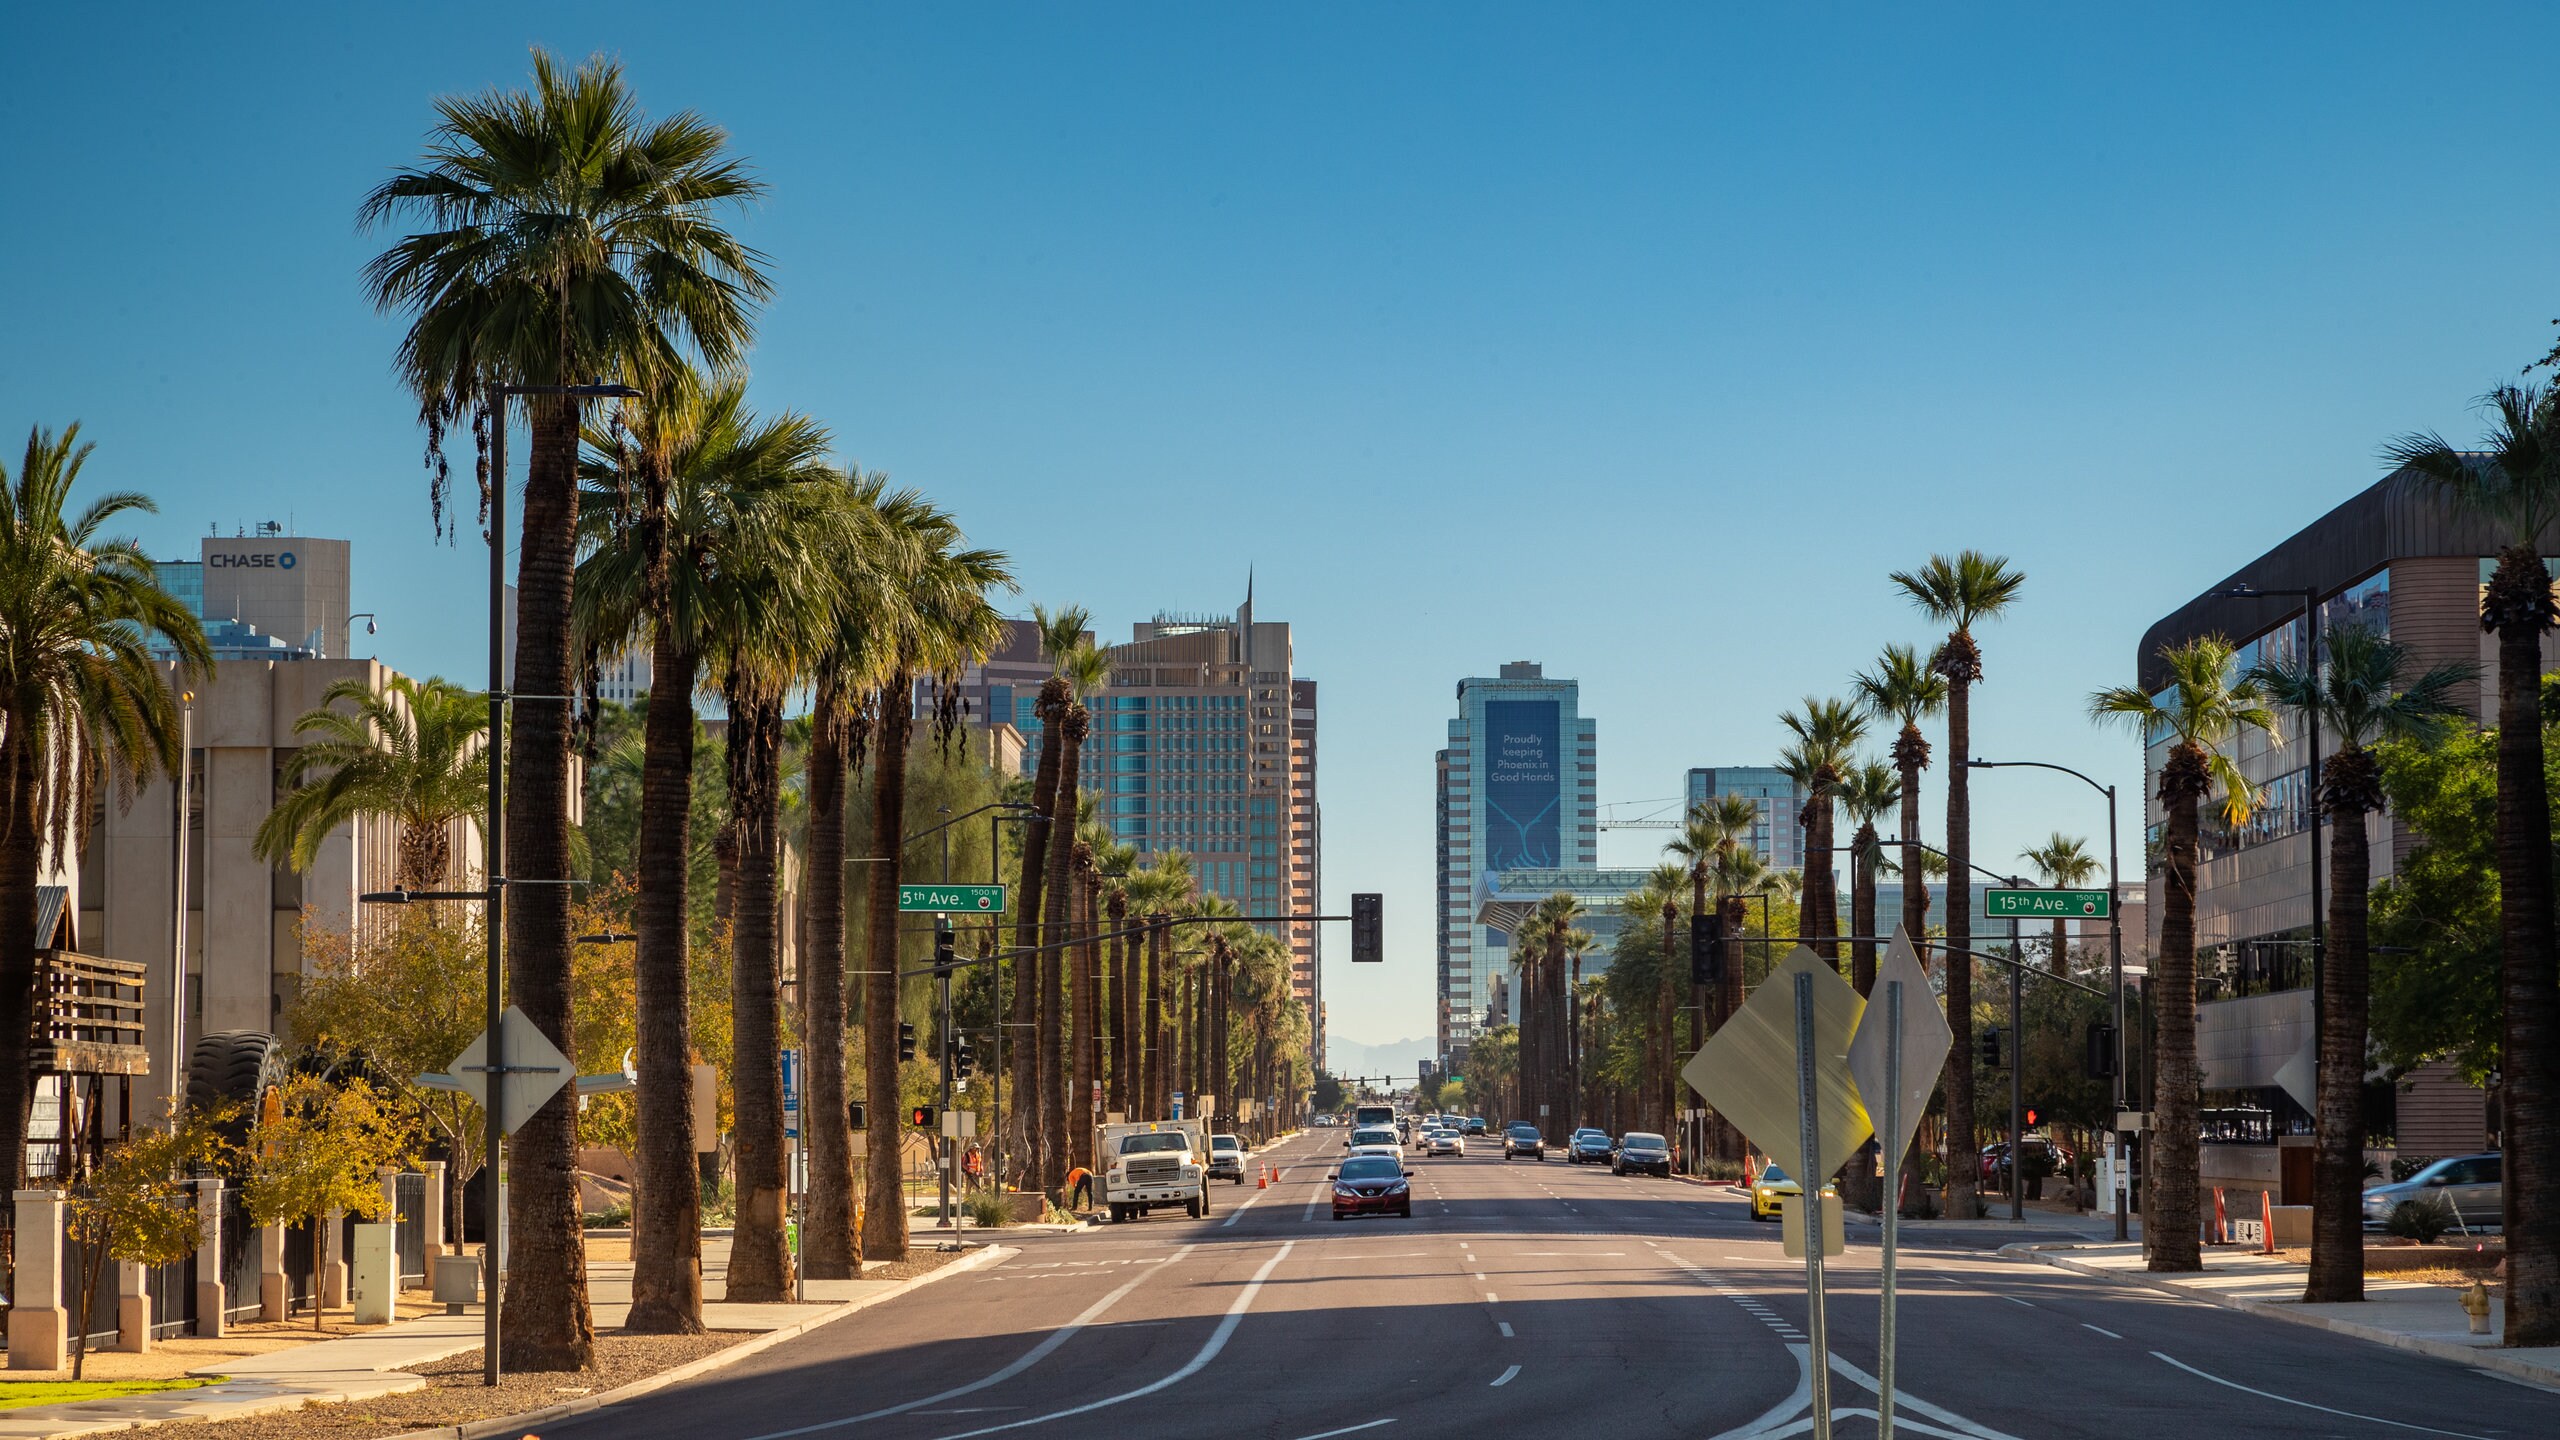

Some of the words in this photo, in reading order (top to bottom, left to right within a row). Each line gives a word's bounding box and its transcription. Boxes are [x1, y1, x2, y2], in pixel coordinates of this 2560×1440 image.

[210, 554, 276, 568] CHASE
[1503, 734, 1542, 745] Proudly
[1502, 747, 1543, 758] keeping
[1497, 760, 1538, 769] Phoenix
[1540, 760, 1549, 769] in
[1491, 772, 1520, 782] Good
[1521, 772, 1555, 782] Hands
[899, 891, 925, 905] 5th
[928, 892, 964, 906] Ave.
[2000, 896, 2030, 910] 15th
[2033, 897, 2069, 911] Ave.
